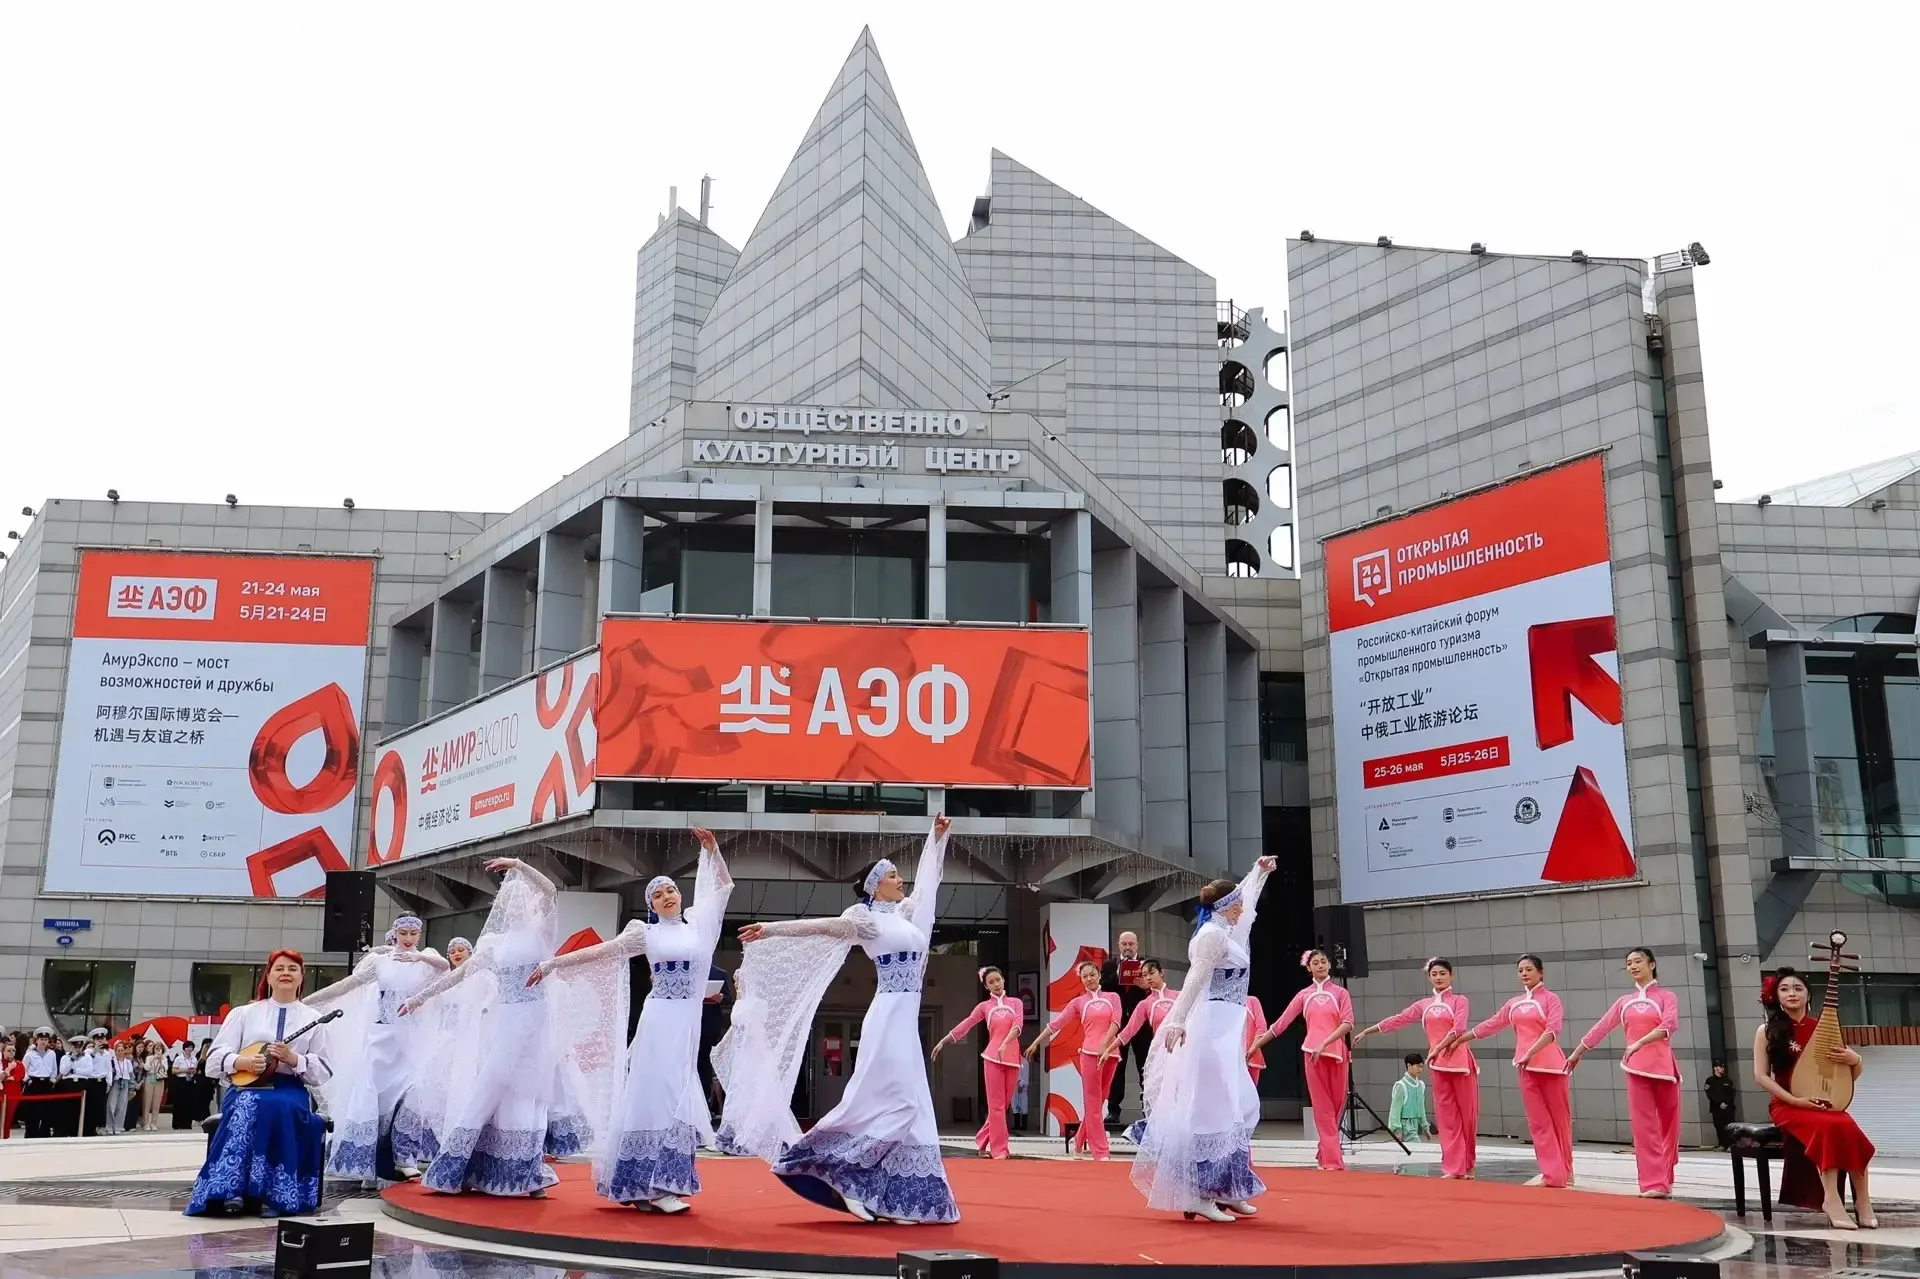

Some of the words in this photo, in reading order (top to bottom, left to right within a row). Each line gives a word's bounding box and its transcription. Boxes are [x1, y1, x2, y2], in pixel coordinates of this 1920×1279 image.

[734, 407, 968, 436] ОБЩЕСТВЕННО
[692, 439, 899, 469] КУЛЬТУРНЫЙ
[925, 446, 1021, 473] ЦЕНТР
[1397, 528, 1469, 564] ОТКРЫТАЯ
[1398, 531, 1544, 586] ПРОМЫШЛЕННОСТЬ
[148, 585, 207, 613] АЭФ
[241, 581, 286, 596] 21-24
[290, 584, 320, 597] мая
[239, 604, 327, 622] 5月21-24日
[1357, 613, 1463, 650] Российско-китайский
[1465, 606, 1499, 626] форум
[101, 652, 179, 670] АмурЭкспо
[196, 657, 230, 669] мост
[1358, 640, 1437, 668] промышленного
[1439, 629, 1481, 649] туризма
[1358, 664, 1409, 683] «Открытая
[1412, 643, 1508, 673] промышленность»
[99, 675, 202, 691] возможностей
[205, 679, 214, 690] и
[217, 678, 274, 694] дружбы
[805, 663, 970, 743] АЭФ
[93, 727, 205, 745] 机遇与友谊之桥
[1361, 703, 1479, 740] 中俄工业旅游论坛
[440, 712, 519, 775] АМУРЭКСПО
[1374, 764, 1403, 778] 25-26
[1405, 762, 1424, 773] мая
[1440, 746, 1499, 767] 5月25-26日
[474, 791, 510, 811] amurexpo.ru
[118, 833, 136, 841] РКС
